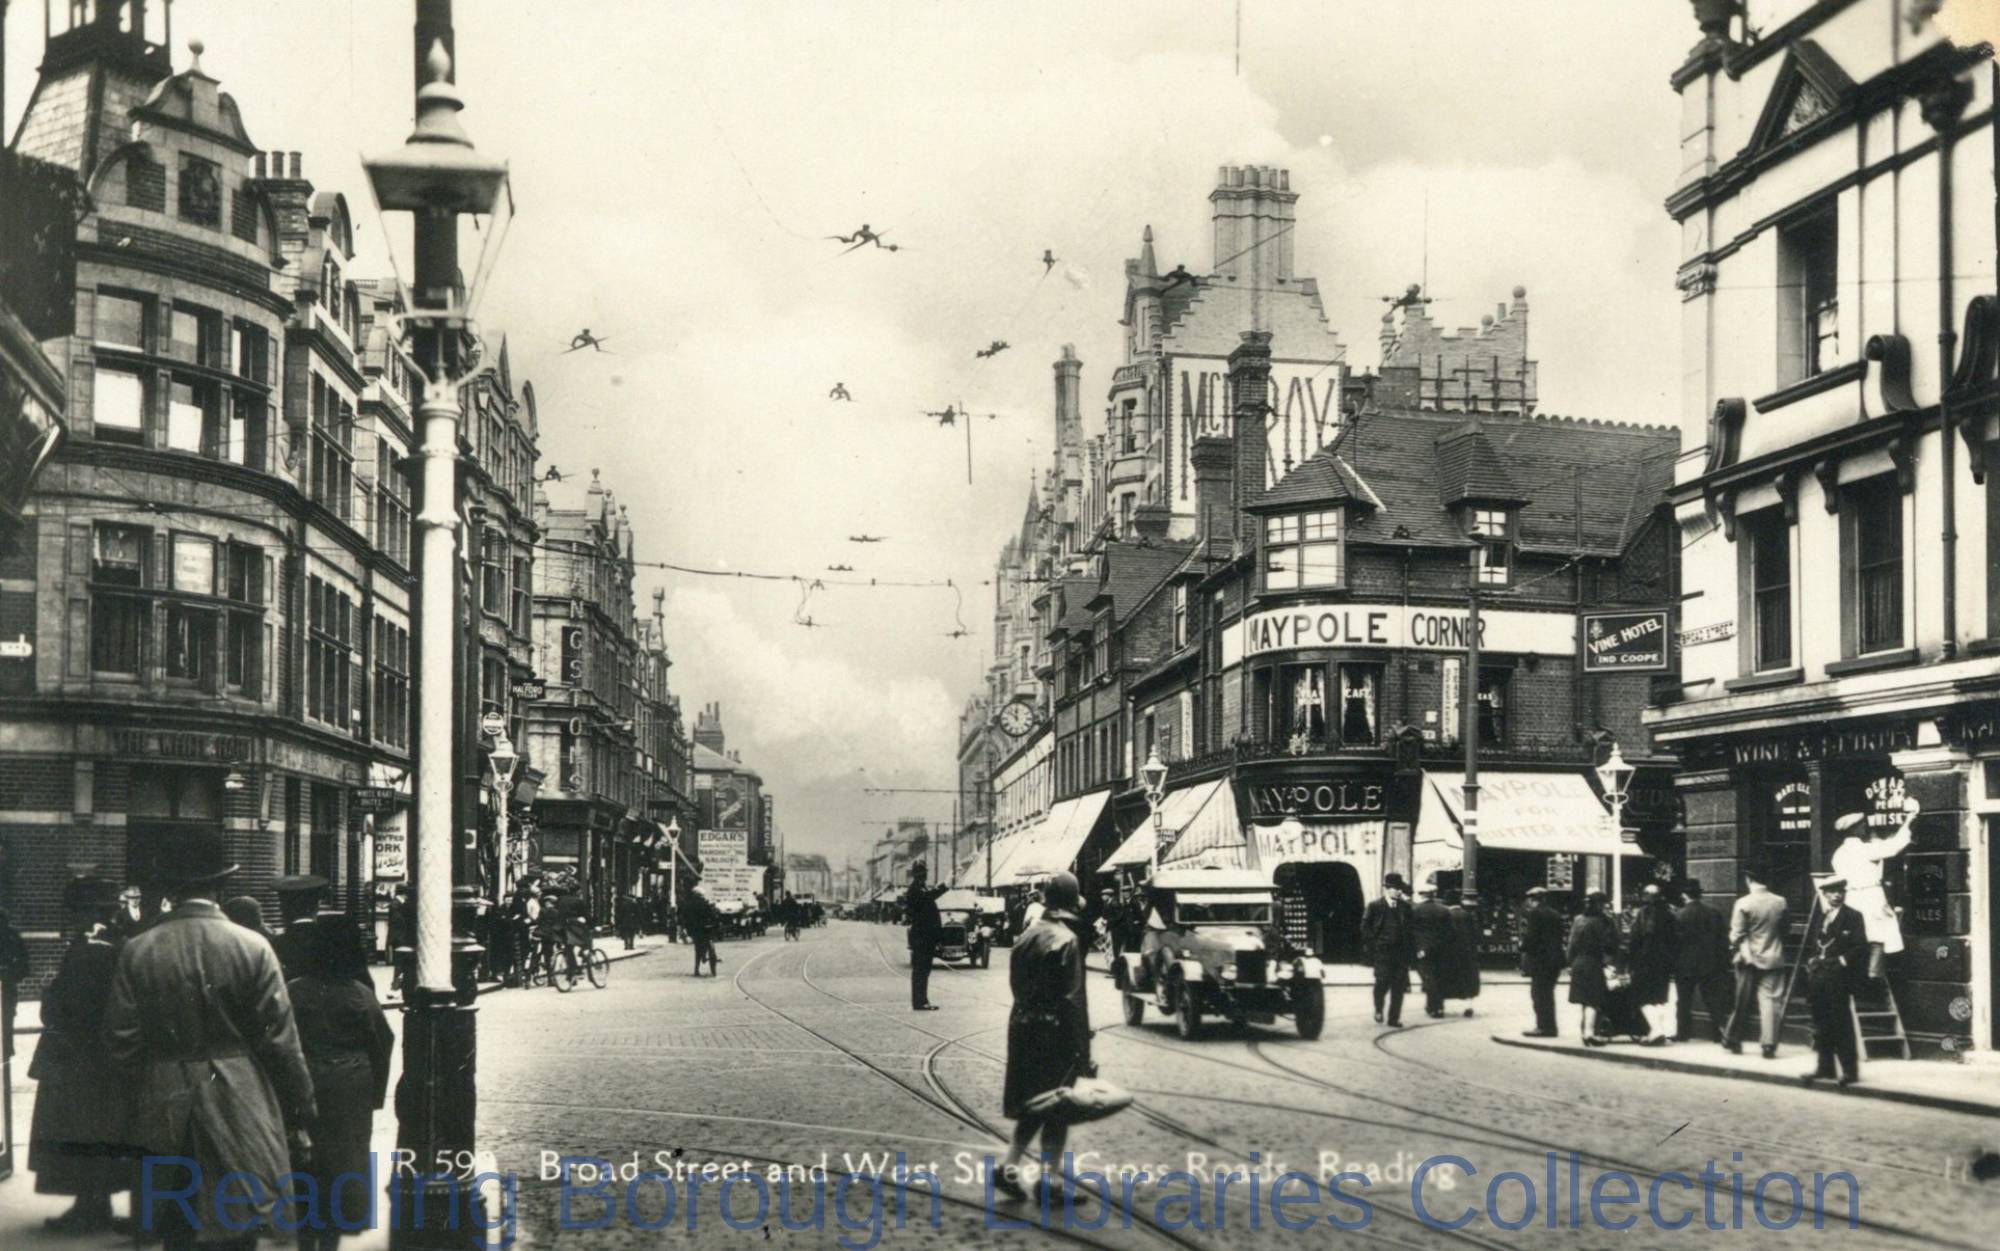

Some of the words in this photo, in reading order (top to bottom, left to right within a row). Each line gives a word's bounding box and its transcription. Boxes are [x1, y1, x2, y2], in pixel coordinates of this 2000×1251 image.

[1250, 611, 1388, 650] MAYPOLE
[1411, 613, 1486, 648] CORNER
[1588, 633, 1620, 654] VINE
[1620, 618, 1662, 642] HOTEL
[1598, 655, 1617, 664] IND
[1620, 653, 1659, 663] COOPE
[512, 685, 543, 694] HALFORD
[1477, 692, 1494, 701] EAS
[1249, 785, 1382, 814] MAYPOLE
[375, 843, 401, 853] ORK
[1259, 829, 1377, 858] MAYPOLE
